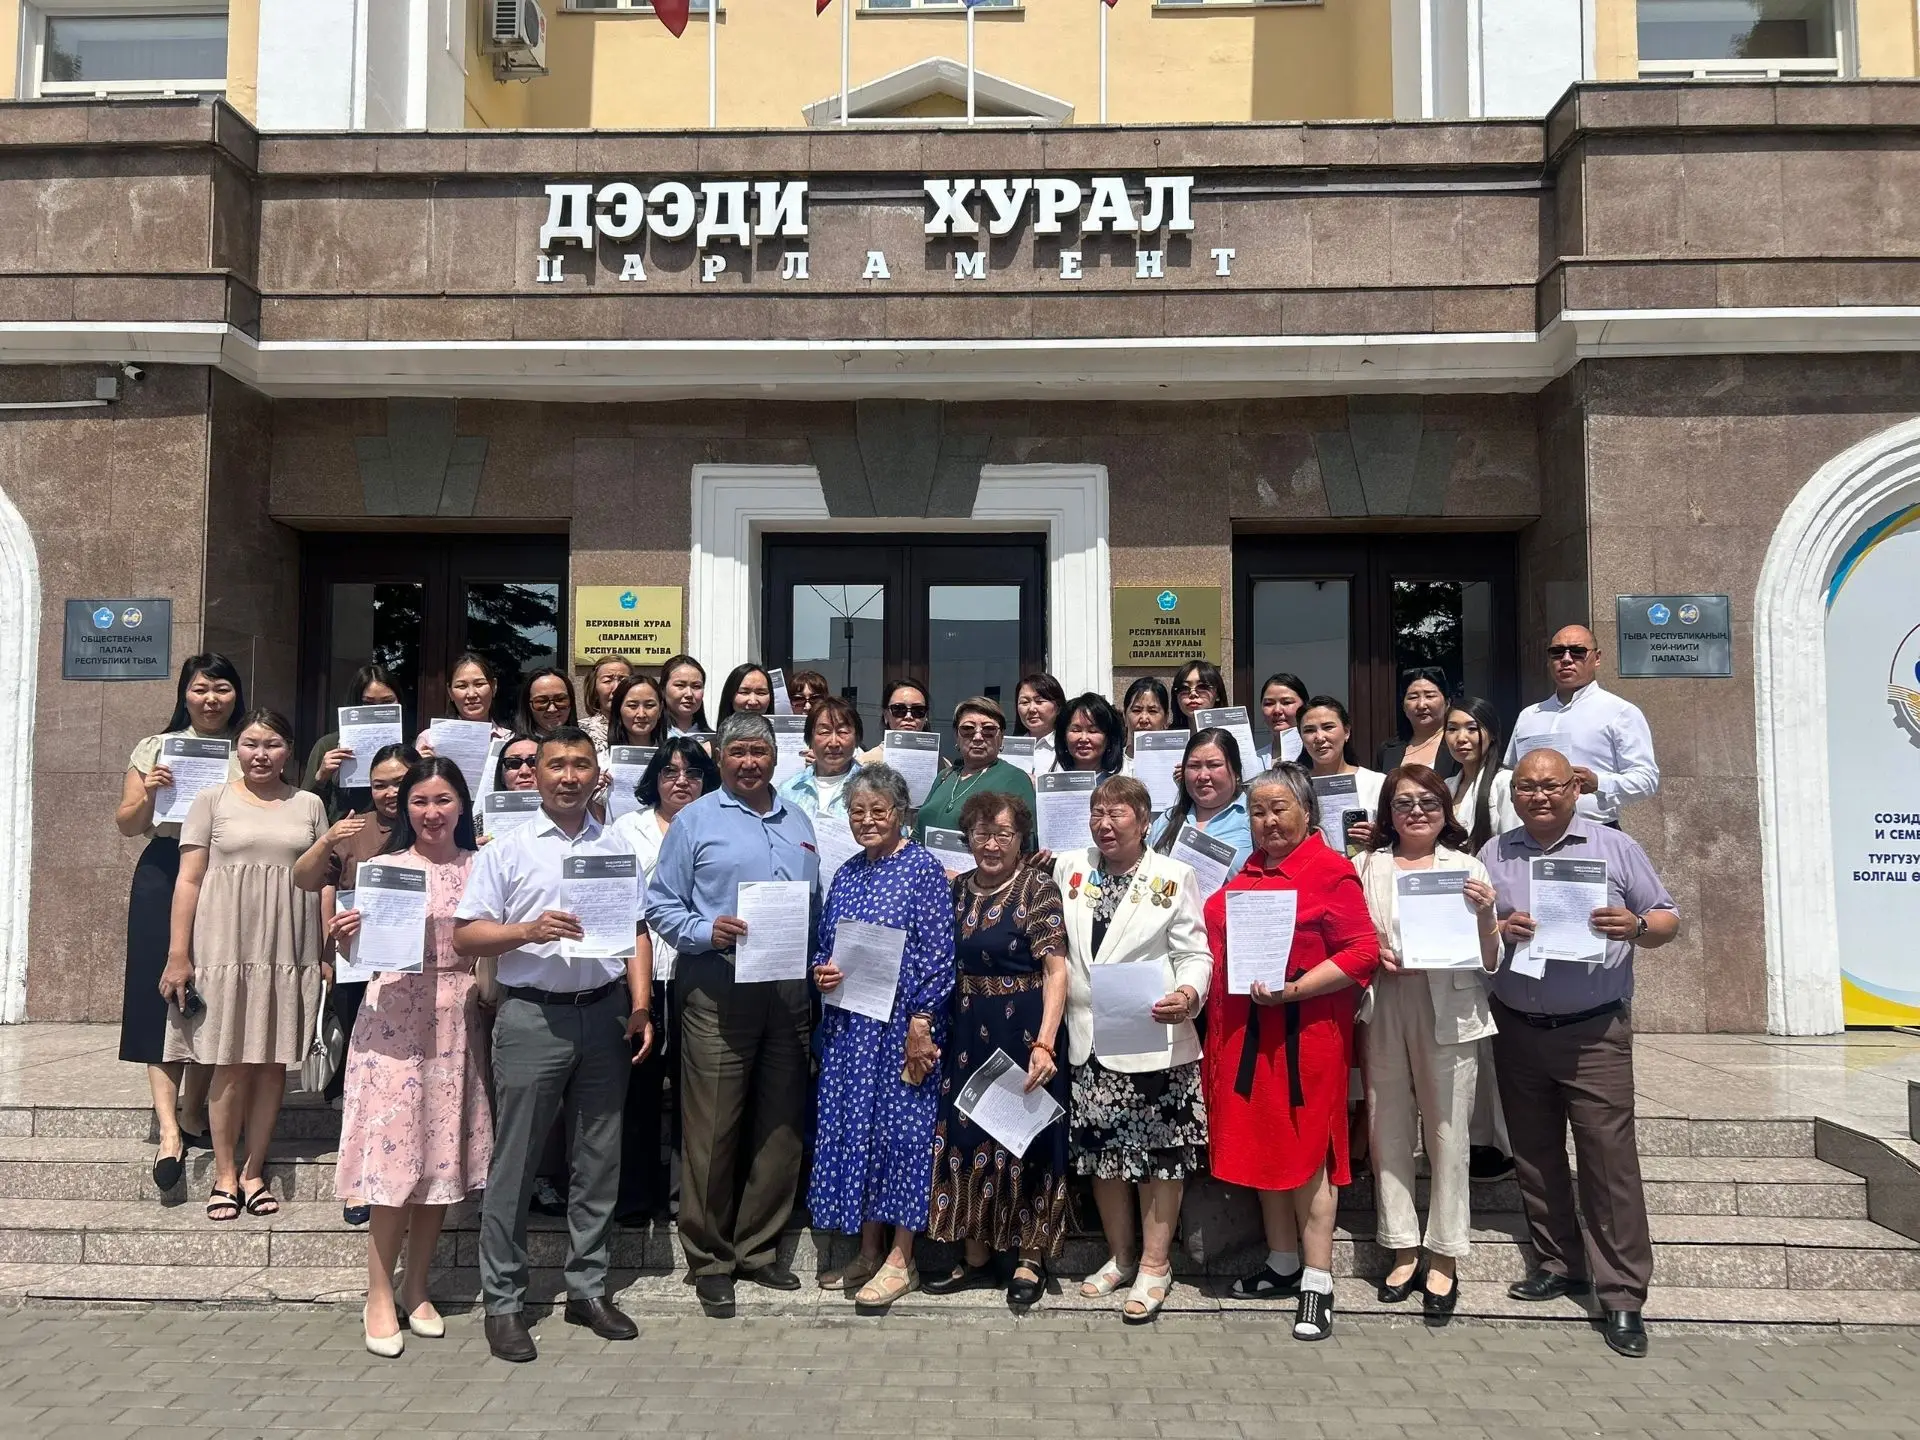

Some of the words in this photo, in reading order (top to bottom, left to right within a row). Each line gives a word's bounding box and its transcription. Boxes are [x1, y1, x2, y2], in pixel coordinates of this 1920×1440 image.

[540, 181, 809, 249] ДЭЭДИ
[923, 176, 1195, 236] ХУРАЛ
[585, 619, 640, 628] ВЕРХОВНЫЙ
[643, 620, 671, 628] ХУРАЛ
[1154, 617, 1181, 625] ТЫВА
[80, 635, 153, 644] ОБЩЕСТВЕННАЯ
[598, 634, 658, 642] (ПАРЛАМЕНТ)
[1623, 632, 1648, 641] ТЫВА
[1165, 639, 1202, 647] ХУРАЛЫ
[99, 646, 133, 654] ПАЛАТА
[584, 647, 641, 655] РЕСПУБЛИКИ
[645, 647, 672, 655] ТЫВА
[75, 657, 130, 665] РЕСПУБЛИКИ
[132, 657, 158, 665] ТЫВА
[1651, 654, 1699, 662] ПАЛАТАЗЫ
[1874, 829, 1885, 839] И
[1853, 871, 1907, 882] БОЛГАШ
